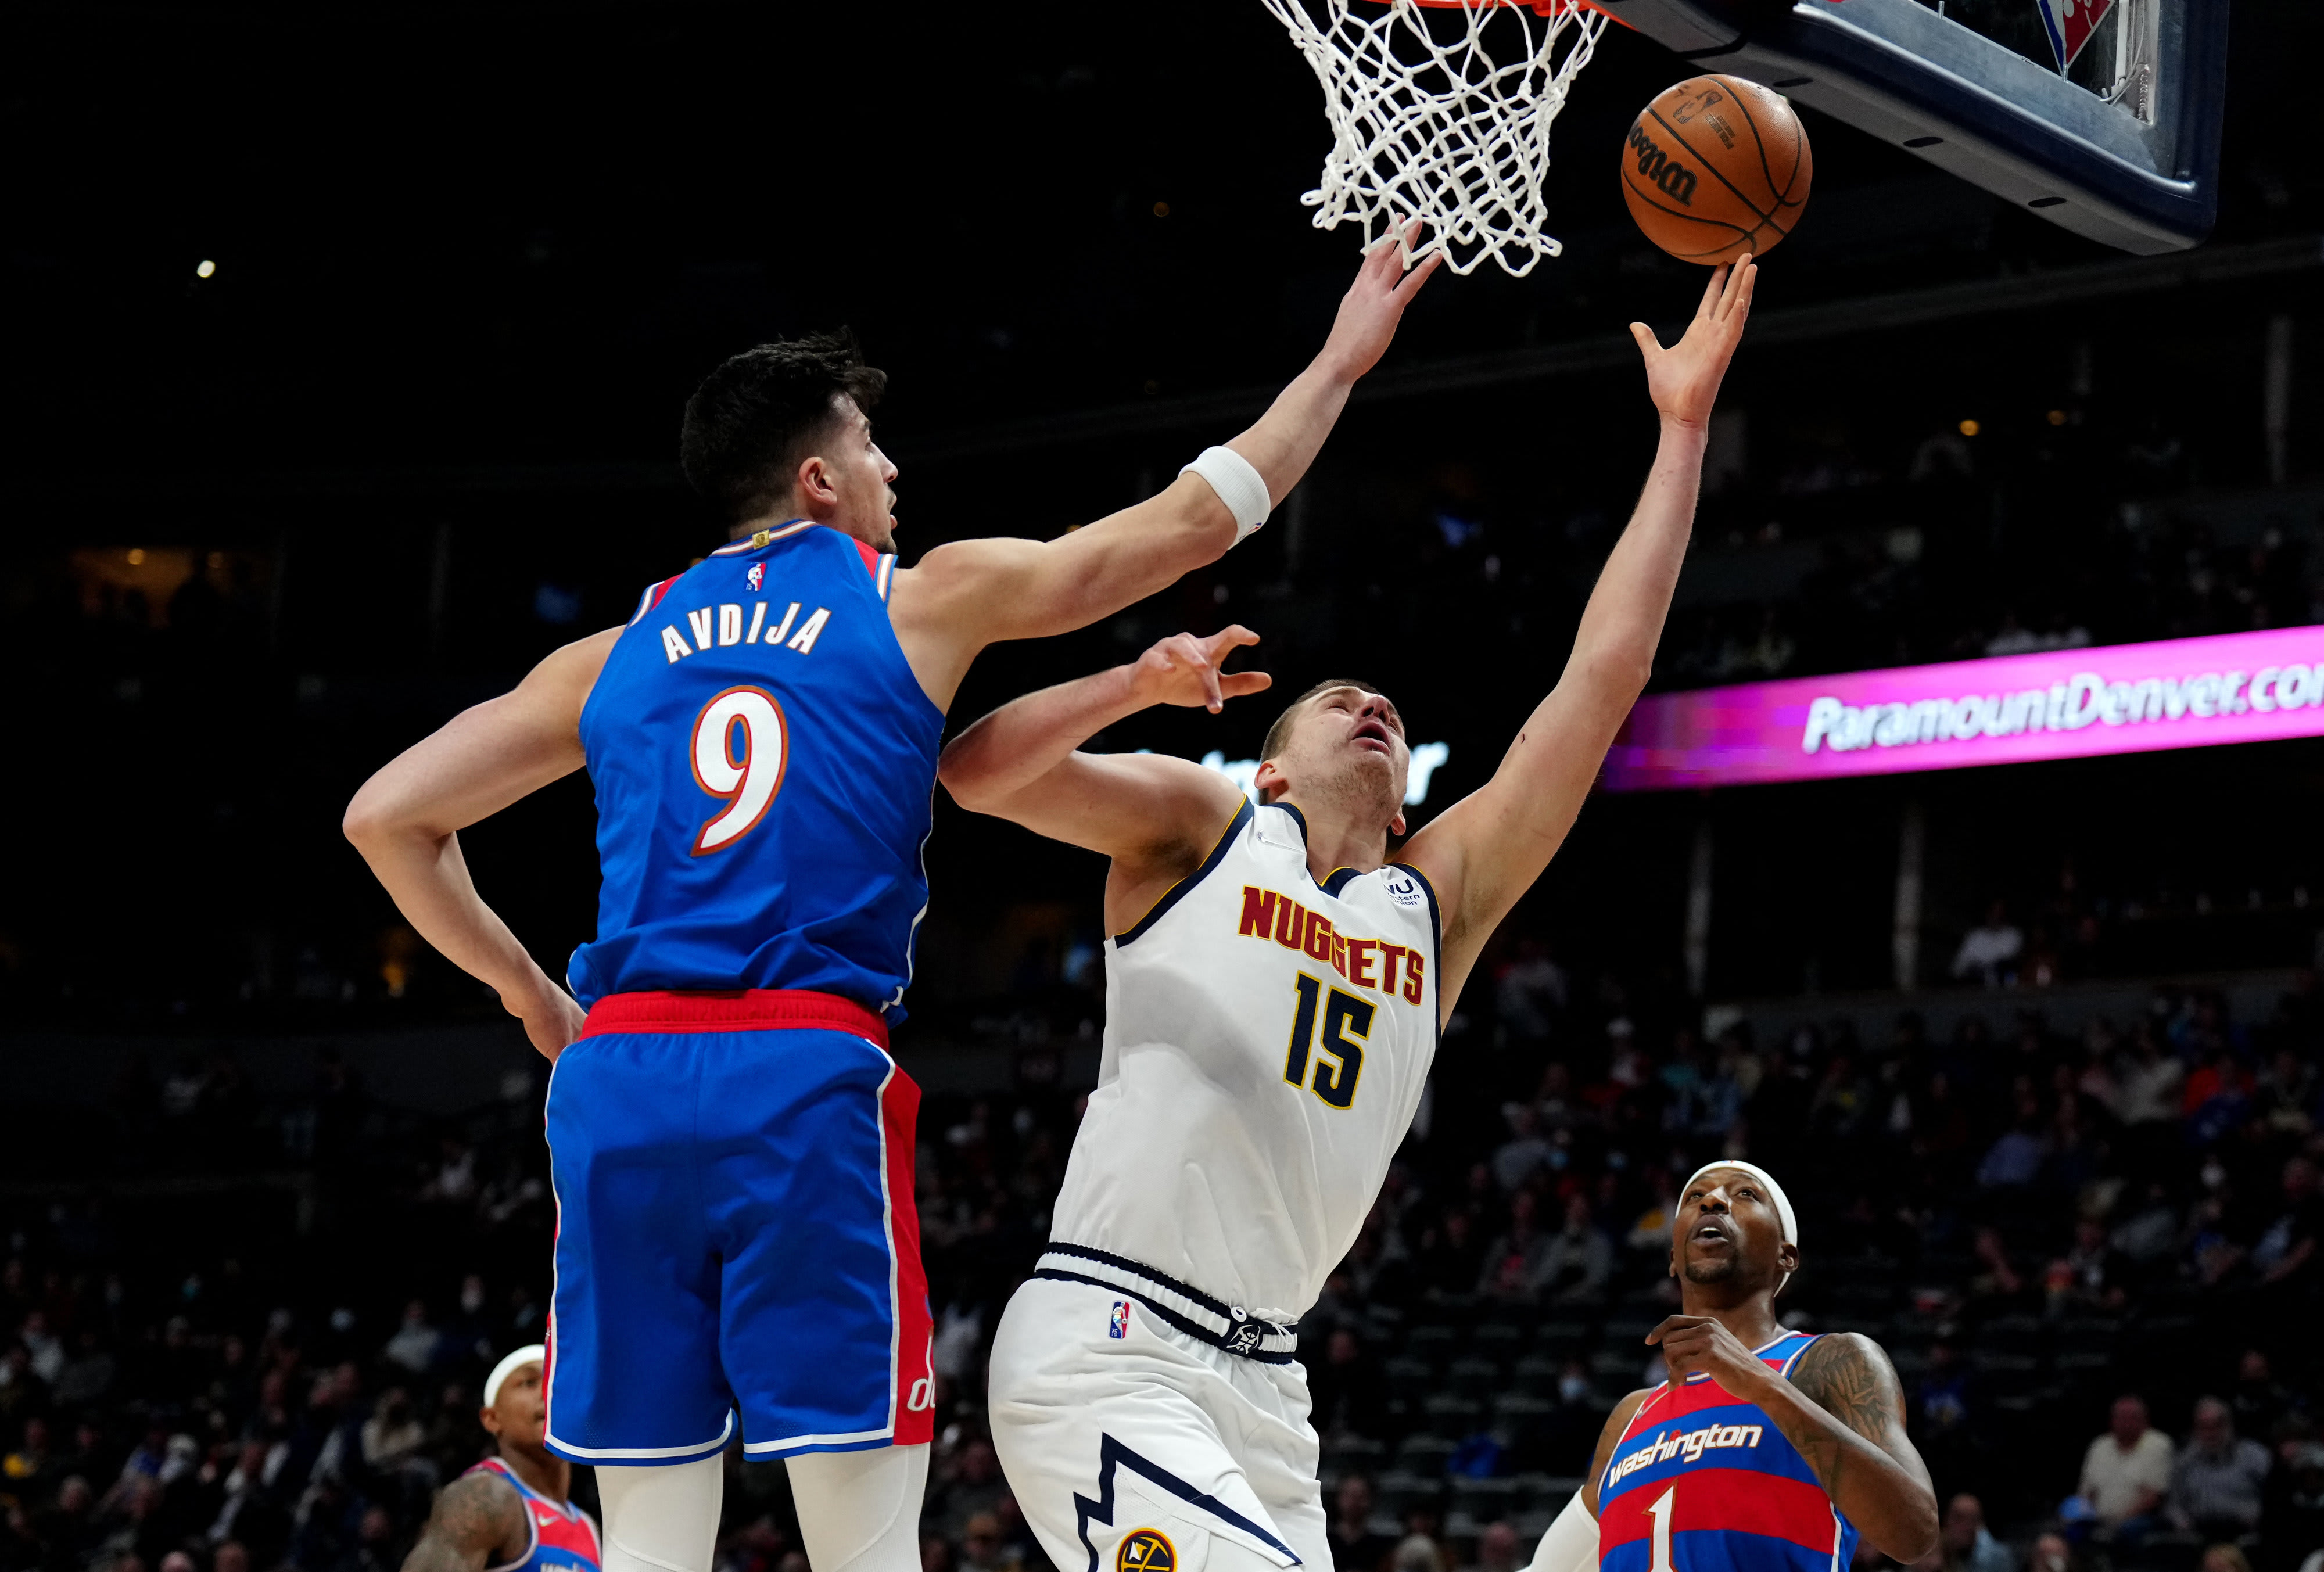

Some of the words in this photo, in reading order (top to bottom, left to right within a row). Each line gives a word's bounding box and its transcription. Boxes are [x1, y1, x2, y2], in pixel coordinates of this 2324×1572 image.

[1628, 120, 1697, 207] Wilso
[661, 601, 832, 665] AVDIJA
[690, 685, 789, 857] 9
[1238, 884, 1425, 1006] NUGGETS
[1283, 970, 1378, 1110] 15
[1608, 1423, 1763, 1490] washington
[1641, 1477, 1679, 1572] 1
